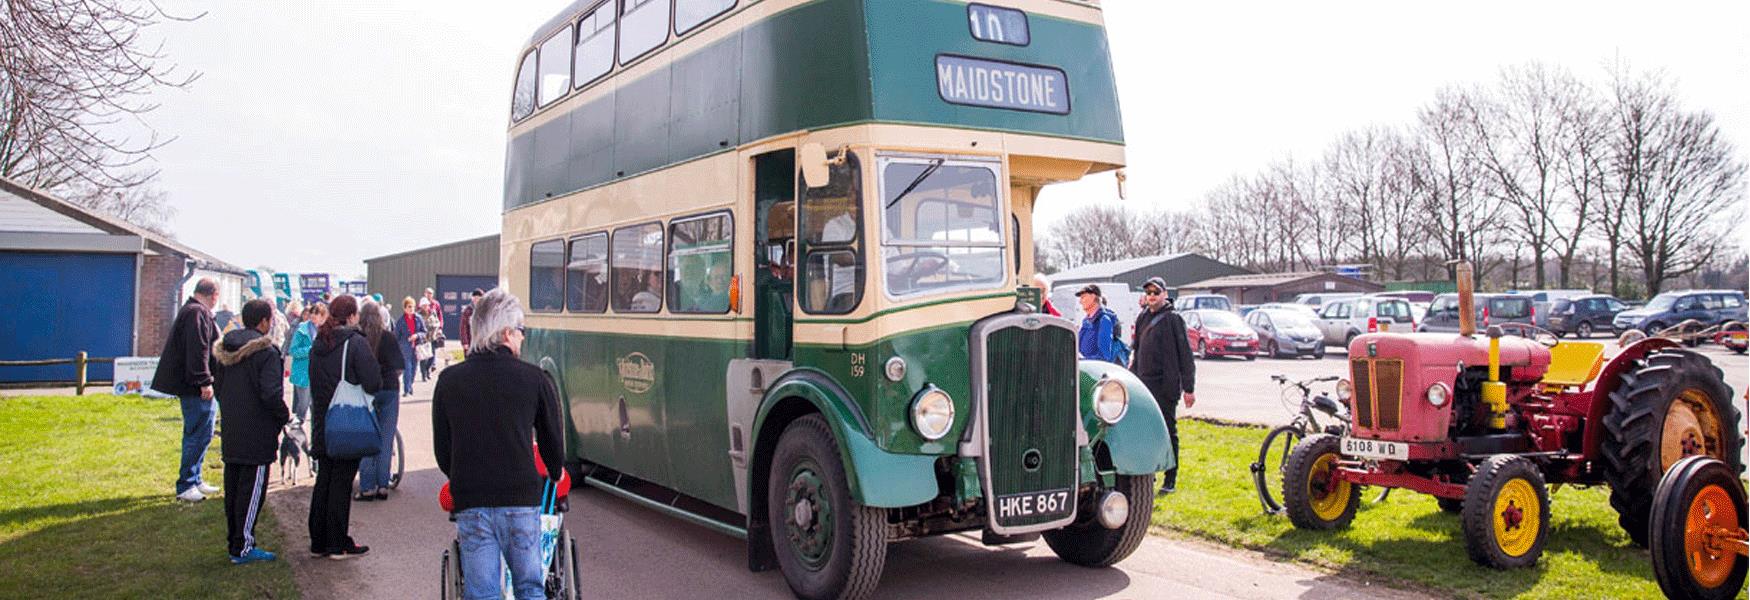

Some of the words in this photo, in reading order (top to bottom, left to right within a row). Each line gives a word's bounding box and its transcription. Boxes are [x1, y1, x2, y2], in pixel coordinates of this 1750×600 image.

[938, 63, 1057, 107] MAIDSTONE
[851, 352, 865, 365] DH
[851, 365, 864, 377] 159
[1000, 496, 1033, 518] HKE
[1036, 491, 1068, 513] 867
